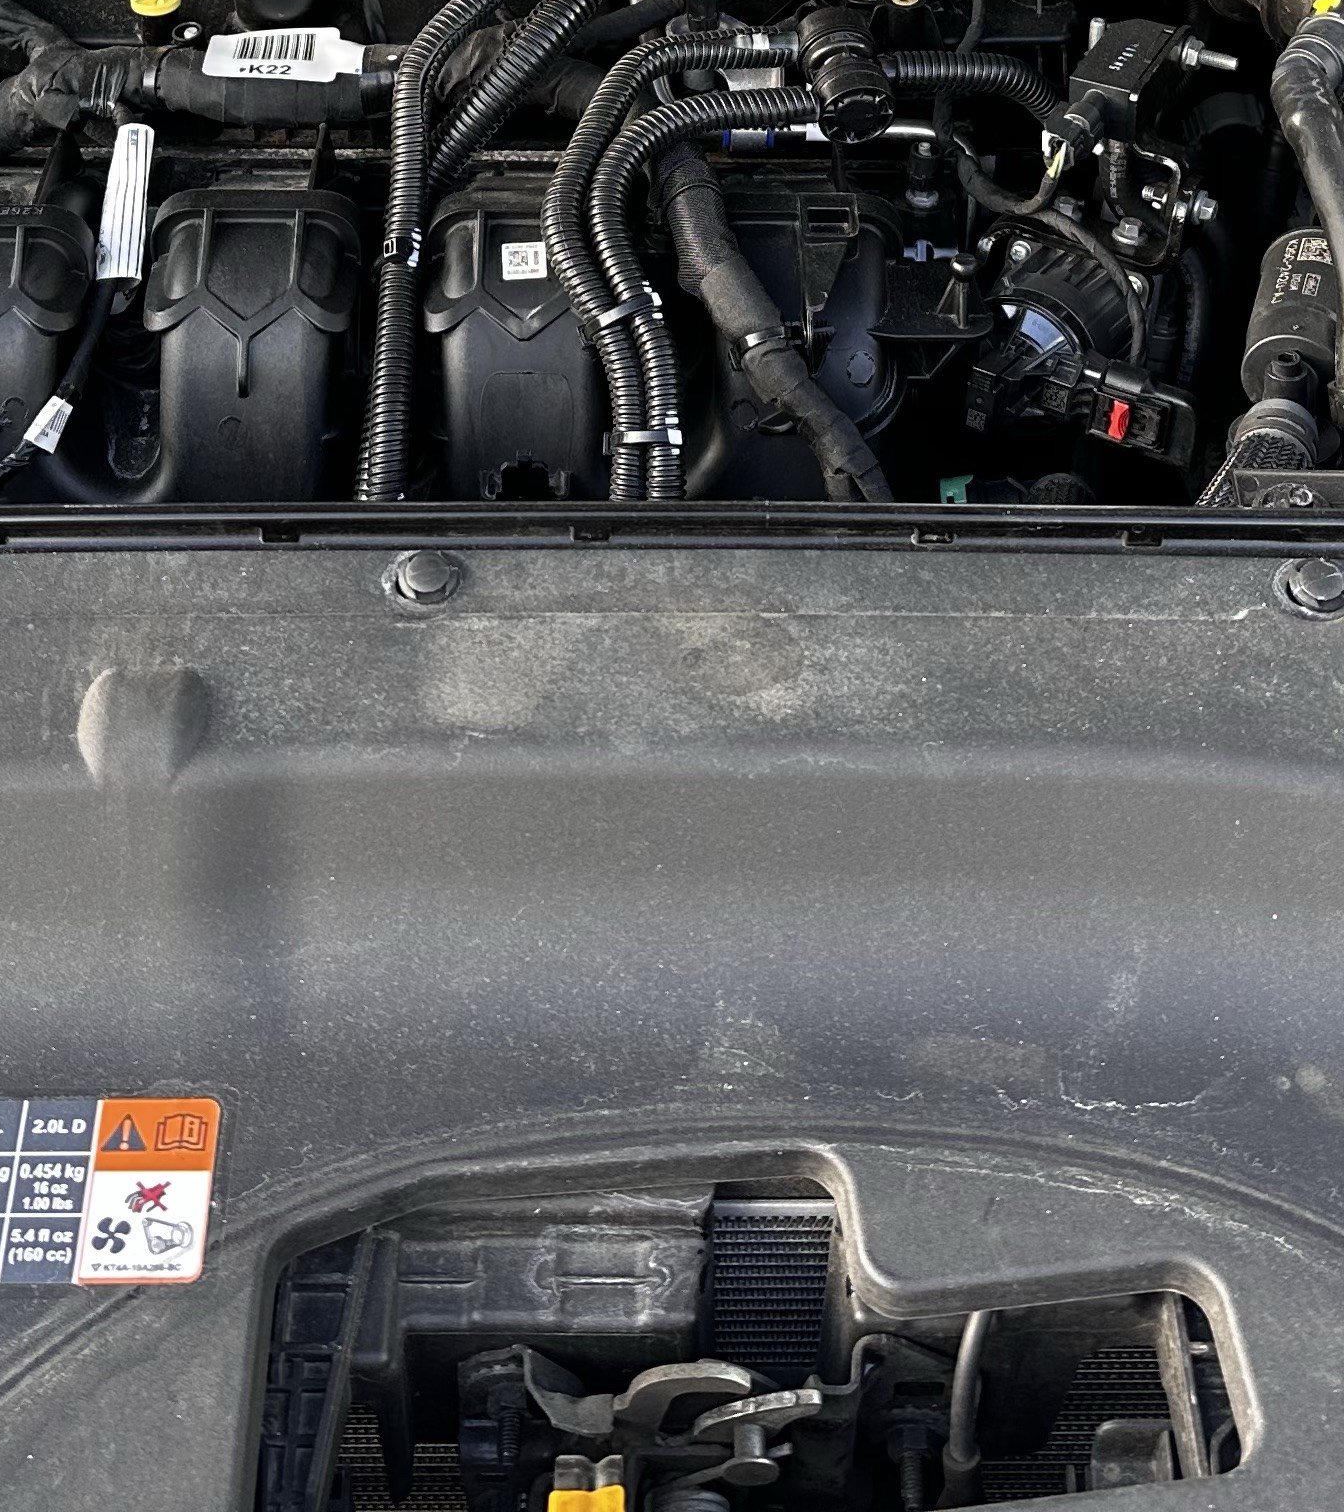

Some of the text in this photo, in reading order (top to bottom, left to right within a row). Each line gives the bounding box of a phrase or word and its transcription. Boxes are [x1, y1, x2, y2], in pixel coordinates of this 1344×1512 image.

[31, 1119, 87, 1135] 2.0L D
[19, 1163, 85, 1183] 0.454 kg
[32, 1182, 69, 1195] 16 oz
[22, 1197, 74, 1210] 1.00 lbs
[10, 1229, 35, 1243] 5.4
[52, 1231, 74, 1243] oz
[8, 1247, 72, 1265] (160 cc)
